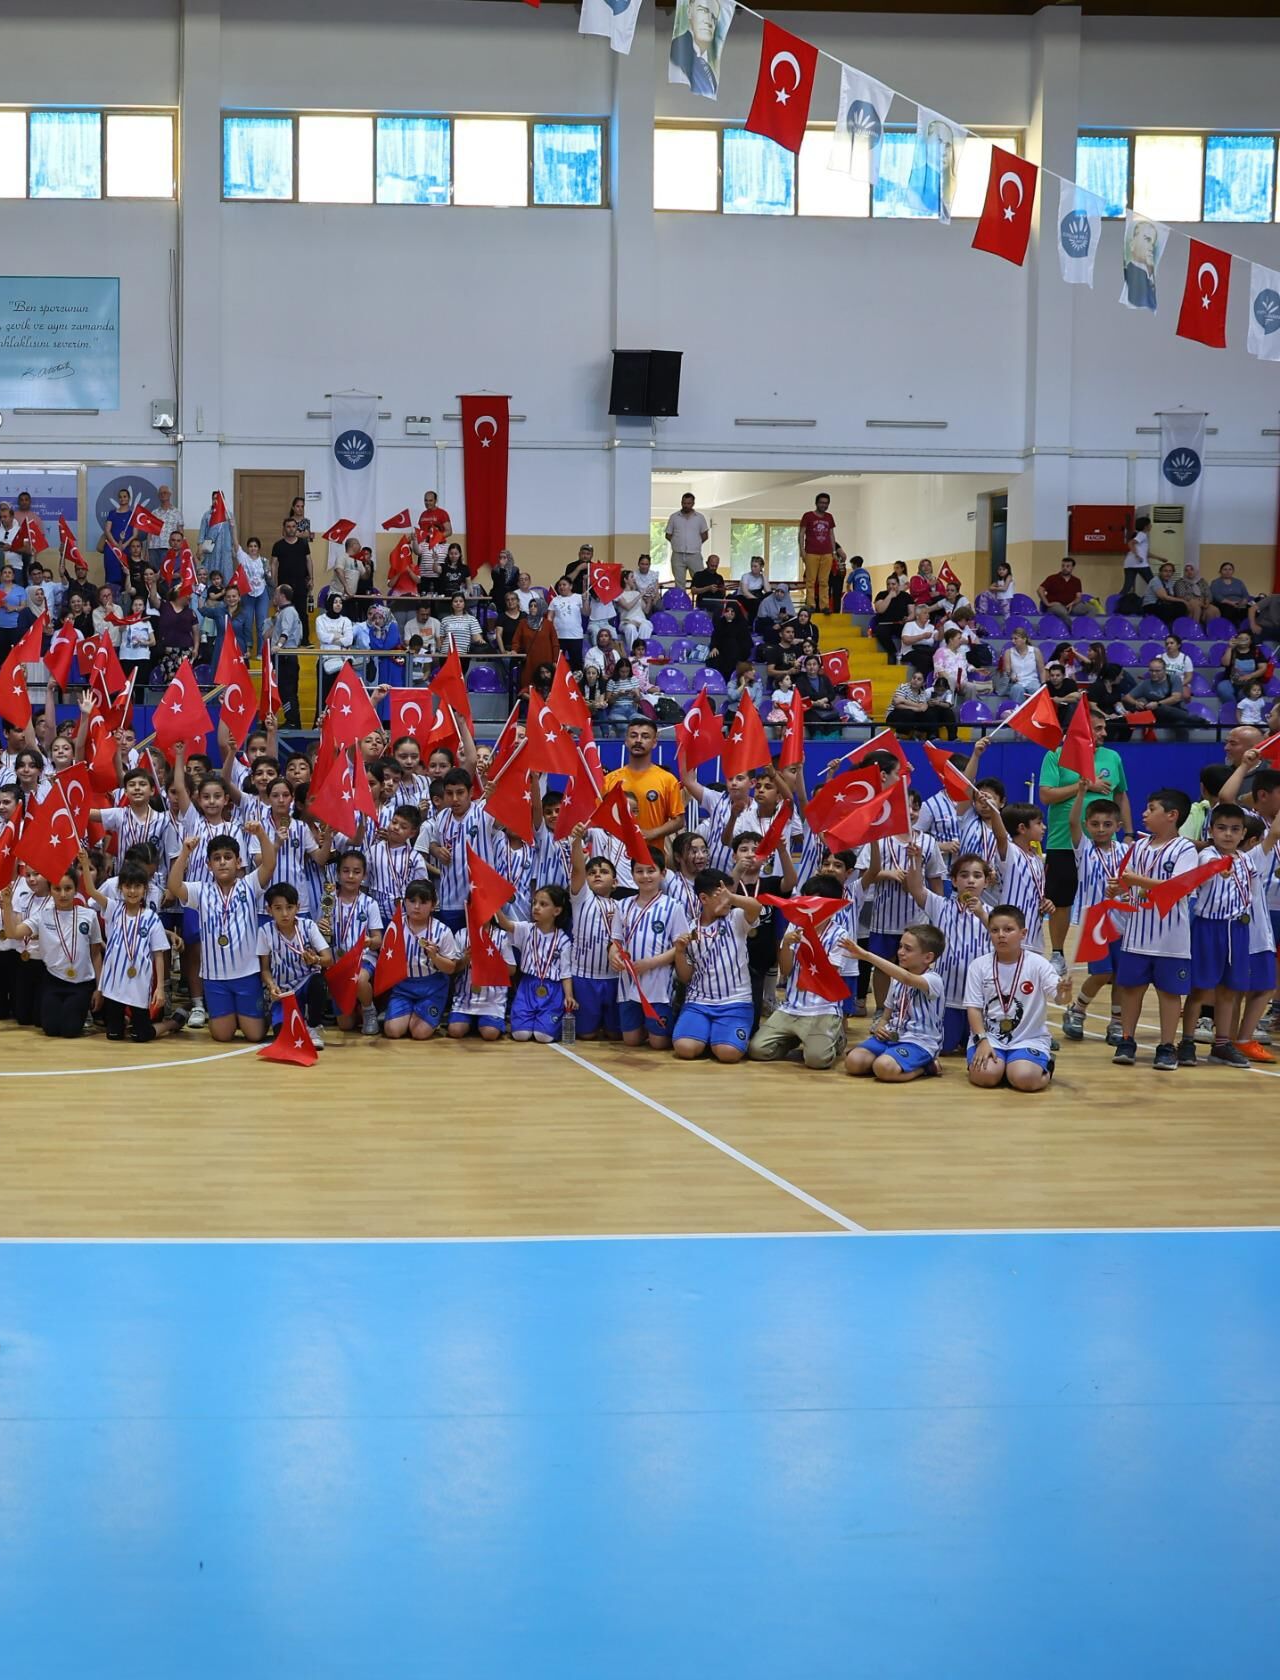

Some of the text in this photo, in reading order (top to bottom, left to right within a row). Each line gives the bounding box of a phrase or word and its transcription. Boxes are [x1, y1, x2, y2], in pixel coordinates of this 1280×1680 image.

[39, 304, 89, 316] sporcunun
[6, 318, 31, 332] çevik
[47, 324, 68, 335] aynı
[71, 319, 115, 331] zamanda
[859, 578, 869, 591] 3
